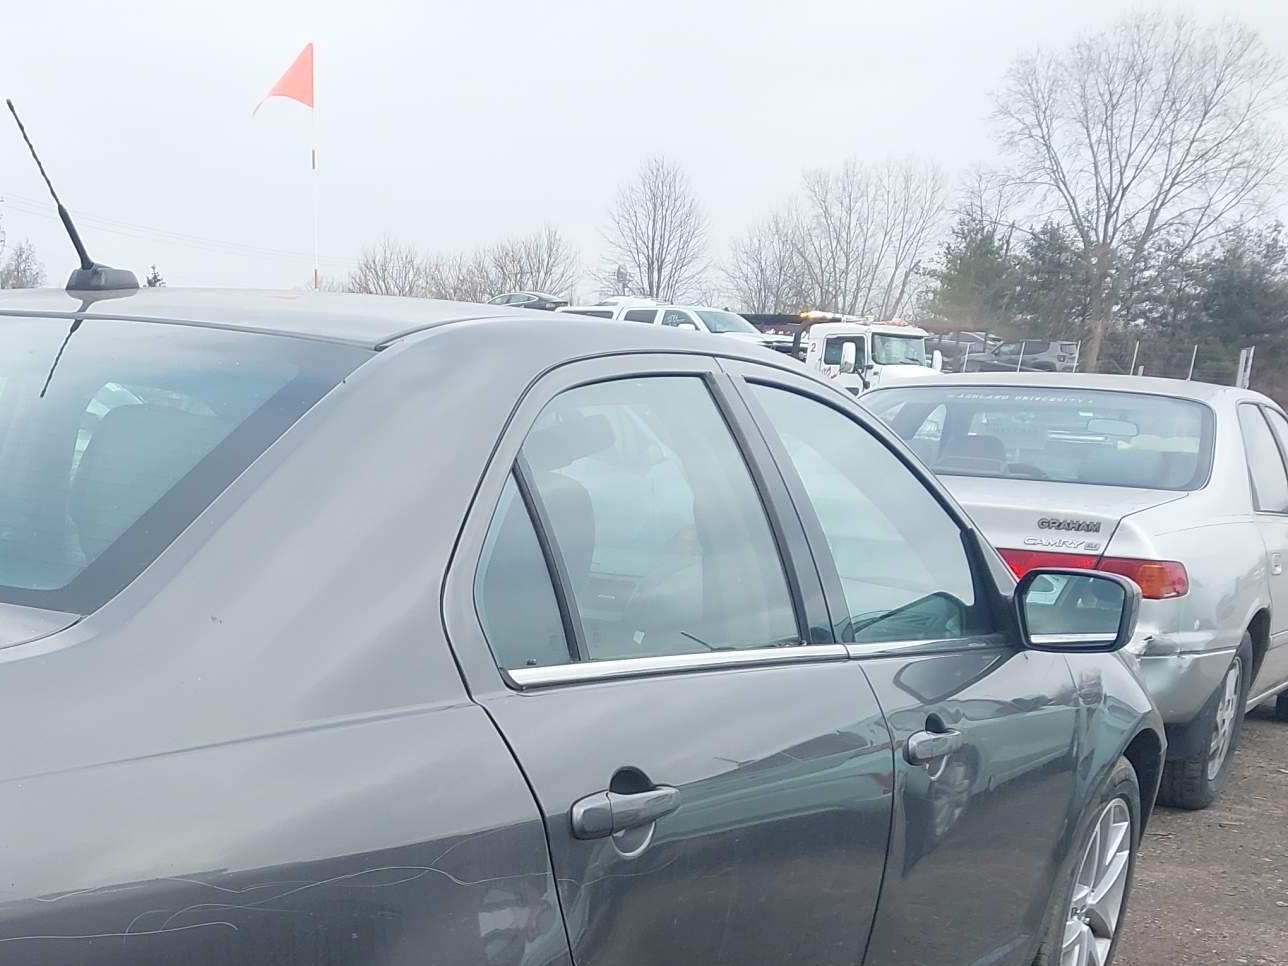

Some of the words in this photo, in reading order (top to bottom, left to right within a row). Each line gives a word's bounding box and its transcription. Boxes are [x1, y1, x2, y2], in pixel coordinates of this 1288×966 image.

[810, 342, 817, 352] 2
[1037, 518, 1101, 532] GRAHAM
[1024, 536, 1085, 548] CAMRY
